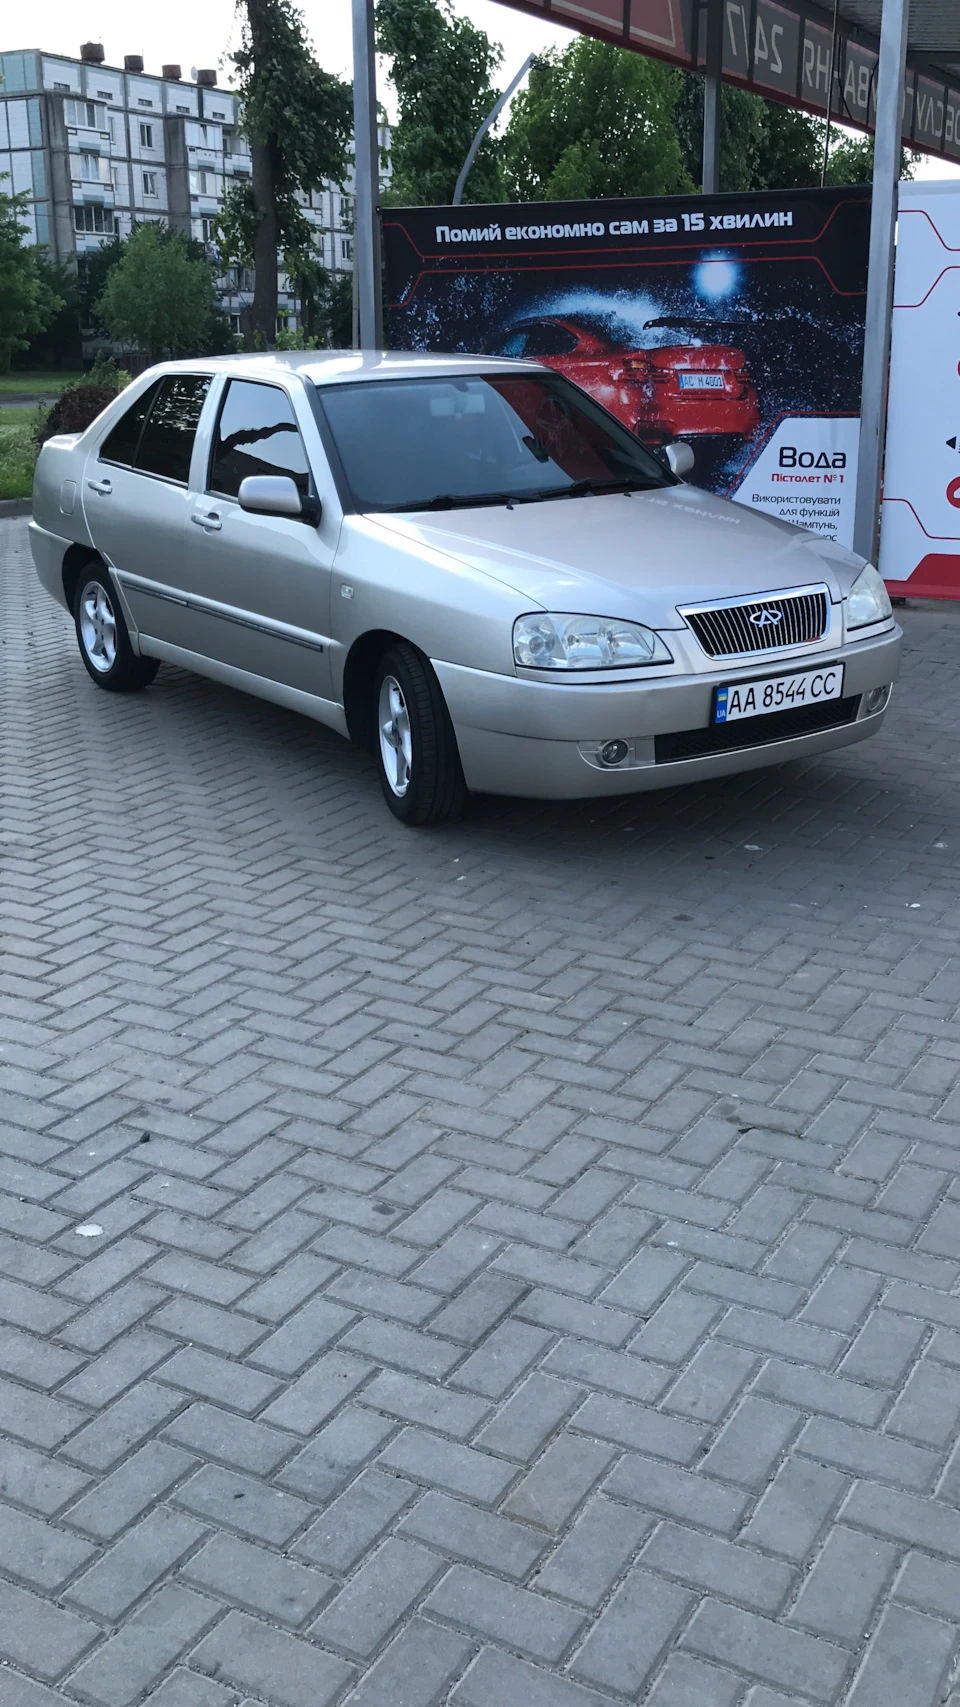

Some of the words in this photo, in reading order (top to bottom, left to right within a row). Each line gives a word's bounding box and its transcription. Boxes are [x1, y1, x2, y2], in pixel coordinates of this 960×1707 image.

[435, 223, 502, 243] Помий
[505, 222, 605, 240] економно
[609, 220, 649, 235] сам
[653, 218, 678, 233] за
[681, 212, 705, 231] 15
[709, 211, 793, 230] хвилин
[778, 446, 847, 469] Вода
[771, 473, 821, 483] Пістолет
[839, 474, 844, 483] 1
[752, 493, 841, 506] Використовувати
[779, 508, 798, 516] для
[799, 507, 840, 518] функцій
[728, 687, 756, 715] AA
[762, 678, 806, 708] 8544
[810, 672, 836, 698] CC
[716, 709, 726, 718] UA
